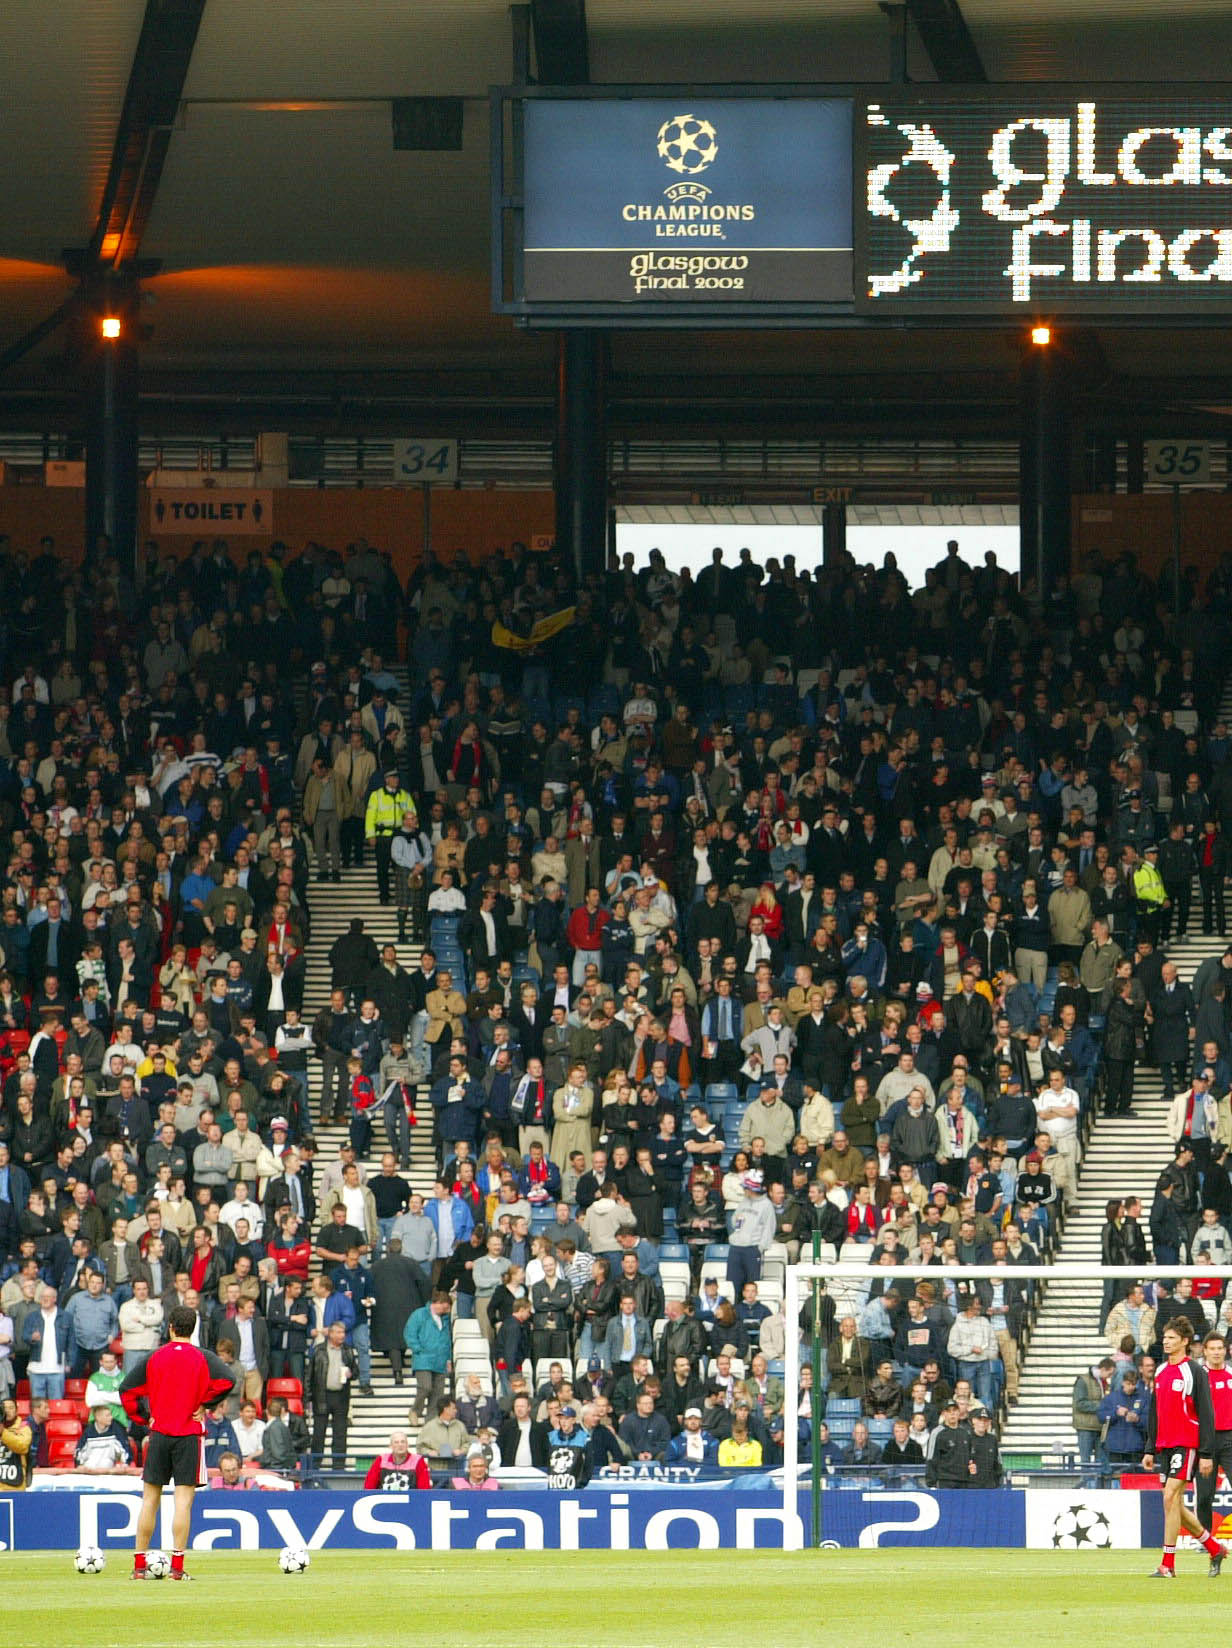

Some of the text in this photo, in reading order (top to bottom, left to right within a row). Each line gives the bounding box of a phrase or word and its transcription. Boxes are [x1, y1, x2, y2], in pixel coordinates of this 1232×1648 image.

[667, 185, 707, 202] UEFA
[622, 204, 755, 221] CHAMPIONS
[656, 224, 723, 237] LEAGUE
[630, 252, 749, 276] glasgow
[634, 274, 745, 293] final 2002
[402, 445, 450, 474] 34
[1155, 446, 1204, 475] 35
[813, 487, 853, 504] EXIT
[171, 503, 247, 520] TOILET
[859, 1491, 941, 1550] 2
